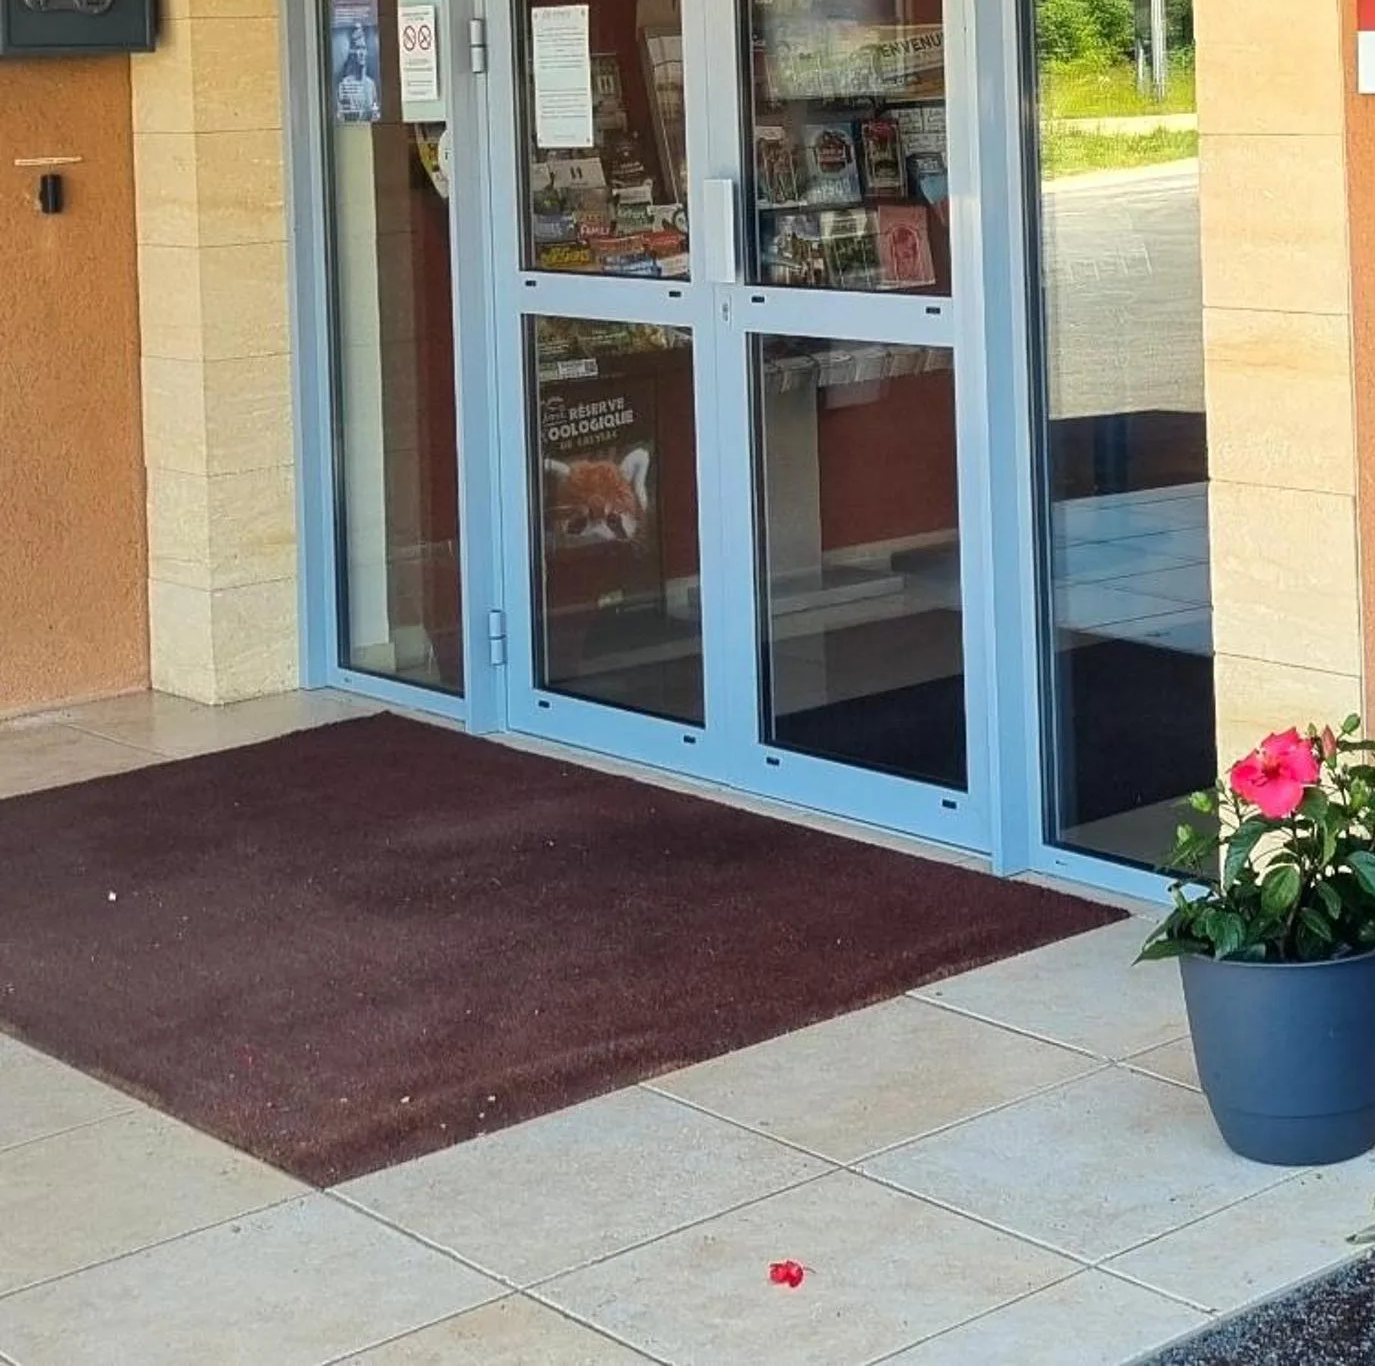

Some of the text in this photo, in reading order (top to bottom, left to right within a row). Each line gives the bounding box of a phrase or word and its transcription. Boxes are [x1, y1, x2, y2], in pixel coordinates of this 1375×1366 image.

[877, 30, 943, 58] ENVENU
[569, 397, 625, 421] RÉSERVE
[545, 409, 634, 442] OOLOGIQUE
